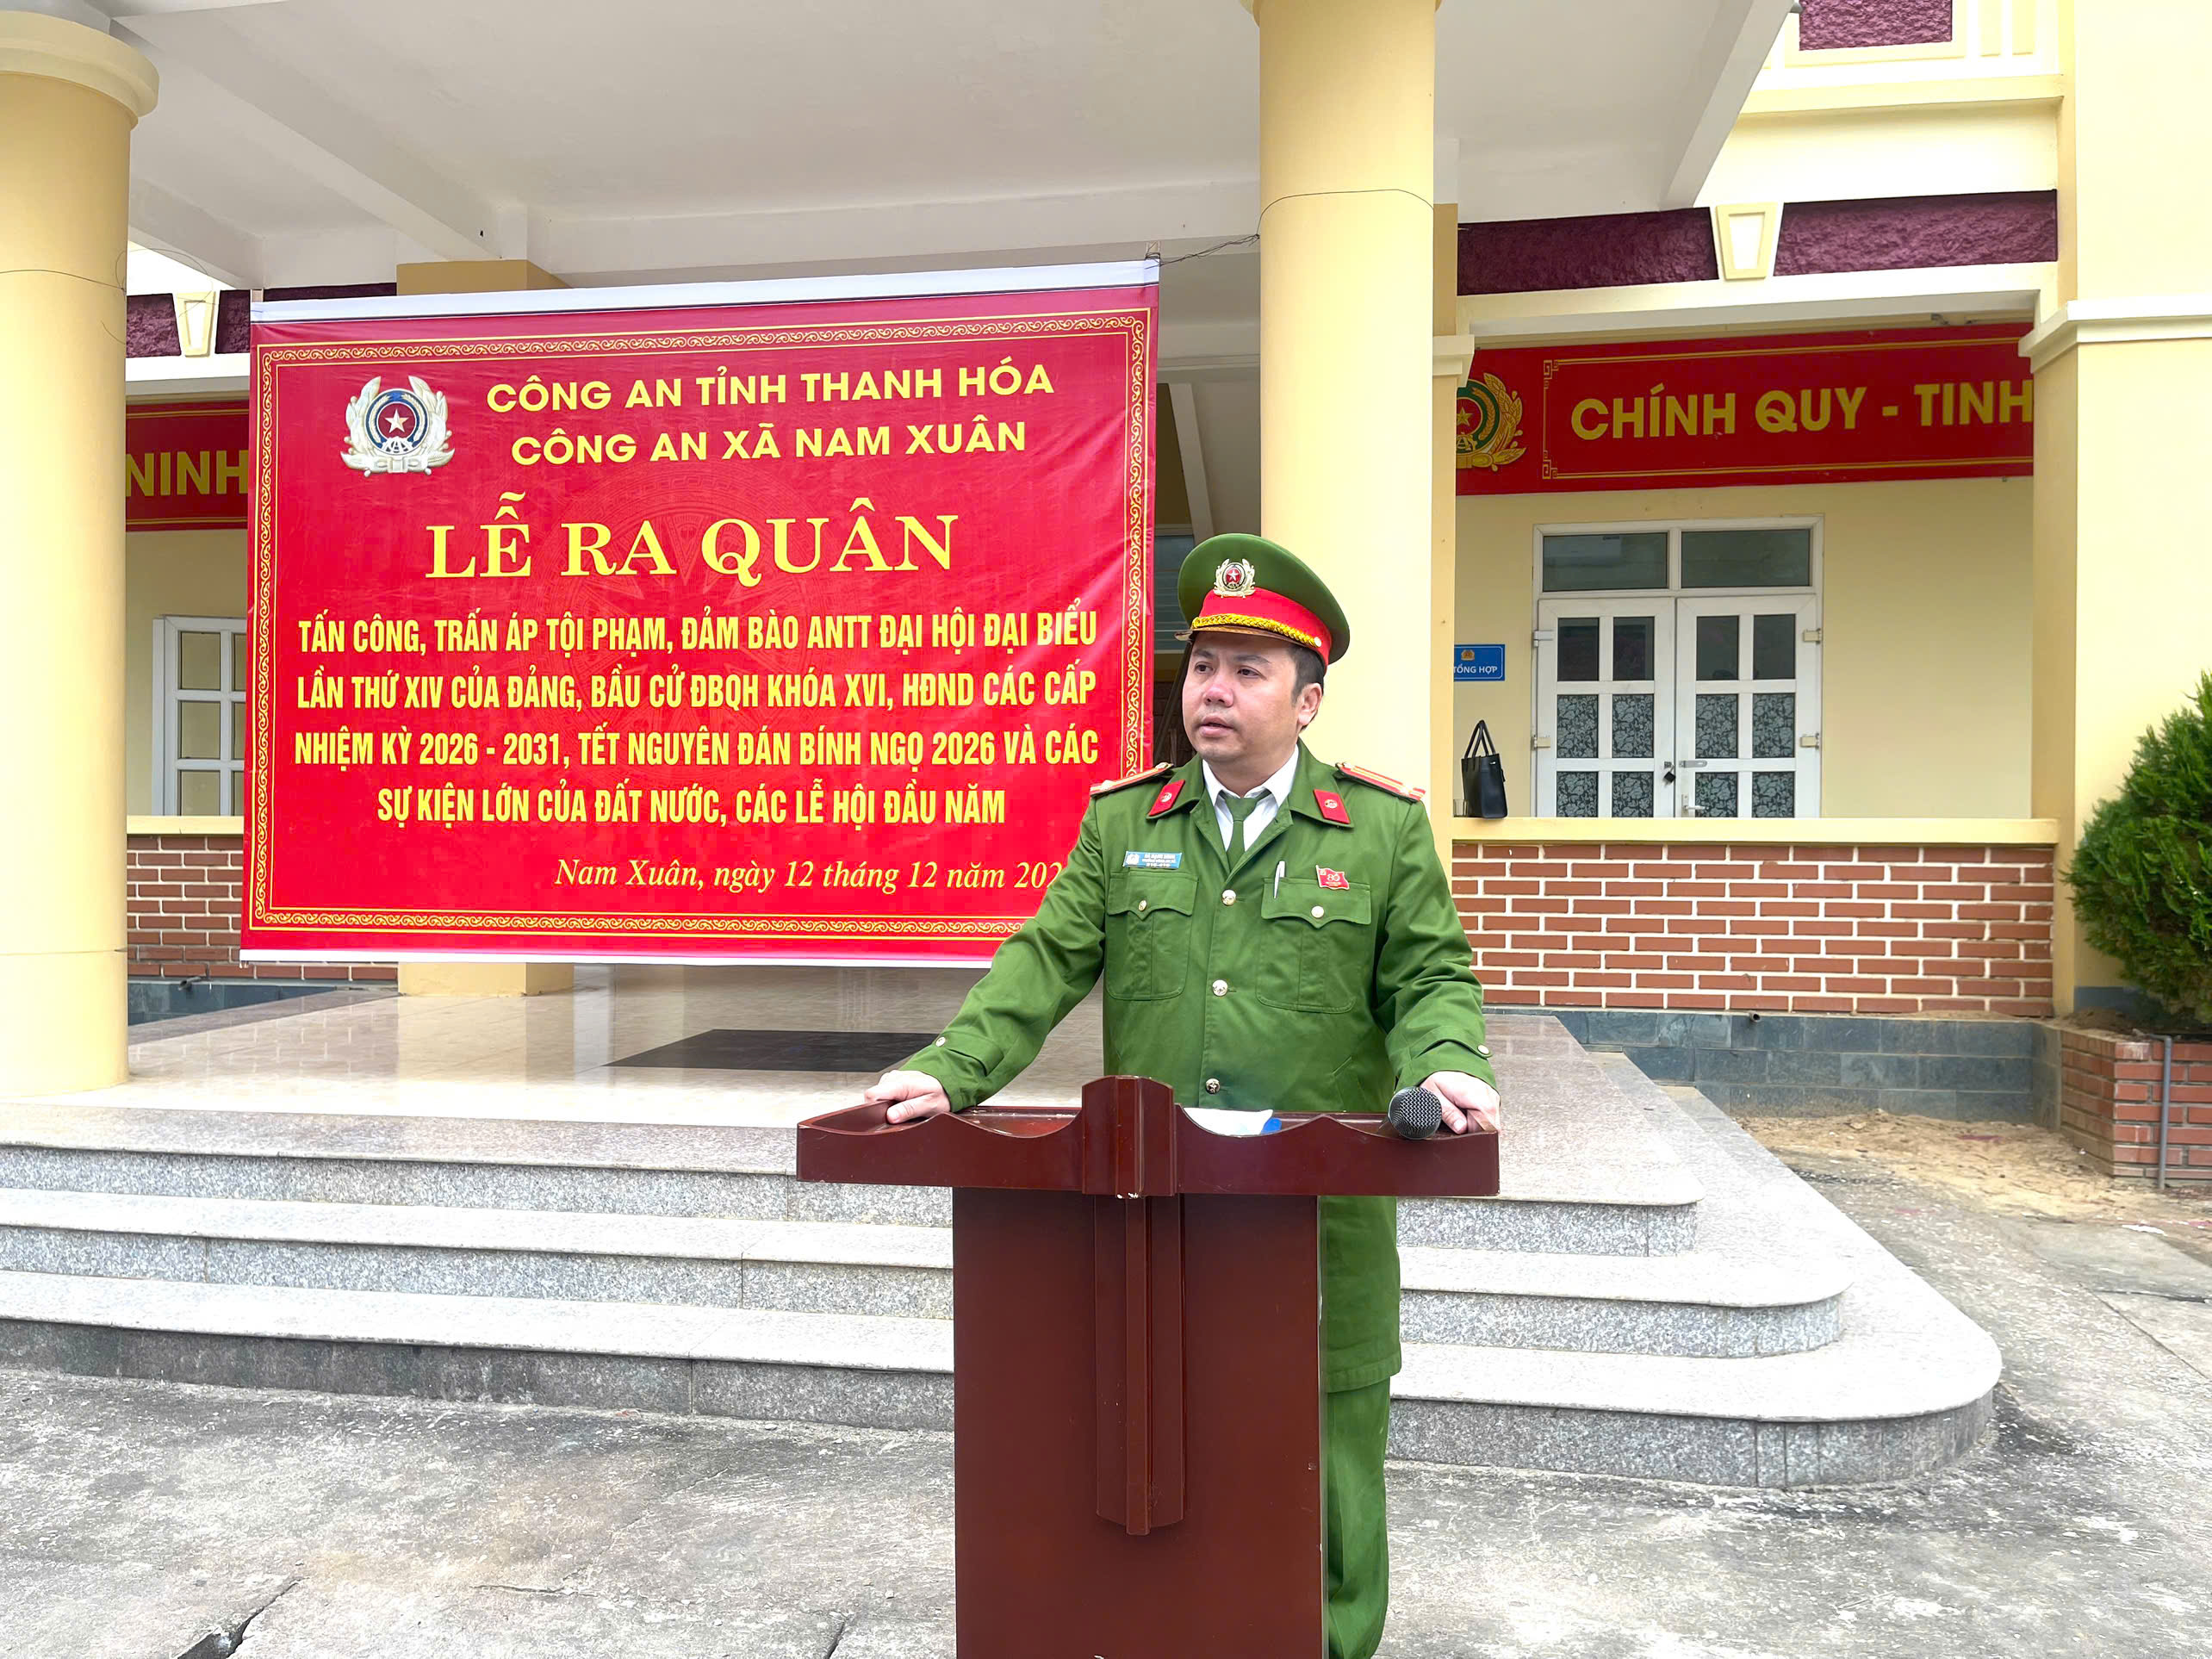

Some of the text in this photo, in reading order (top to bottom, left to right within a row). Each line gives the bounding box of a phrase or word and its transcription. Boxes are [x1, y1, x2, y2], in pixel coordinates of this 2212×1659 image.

[487, 354, 1055, 413] CÔNG AN TỈNH THANH HÓA
[1571, 380, 2033, 439] CHÍNH QUY - TINH
[511, 413, 1026, 466] CÔNG AN XÃ NAM XUÂN
[126, 450, 249, 496] NINH
[425, 491, 959, 587] LỄ RA QUÂN
[298, 597, 1097, 659] TẤN CÔNG, TRẤN ÁP TỘI PHẠM, ĐẢM BÀO ANTT ĐẠI HỘI ĐẠI BIỂU
[297, 658, 1097, 712] LẦN THỨ XIV CỦA ĐẢNG, BẦU CỬ ĐBQH KHÓA XVI, HĐND CÁC CẤP
[295, 725, 374, 772] NHIỆM
[382, 725, 413, 765] KỲ
[419, 732, 478, 766] 2026
[502, 732, 570, 769] 2031,
[577, 721, 621, 765] TẾT
[628, 724, 730, 766] NGUYÊN
[736, 724, 791, 766] ĐÁN
[799, 724, 861, 766] BÍNH
[870, 730, 924, 773] NGỌ
[931, 731, 996, 766] 2026
[1003, 723, 1037, 765] VÀ
[1045, 723, 1098, 765] CÁC
[377, 778, 1005, 831] SỰ KIỆN LỚN CỦA ĐẤT NƯỚC, CÁC LỄ HỘI ĐẦU NĂM
[554, 859, 1063, 895] Nam Xuân, ngày 12 tháng 12 năm 202
